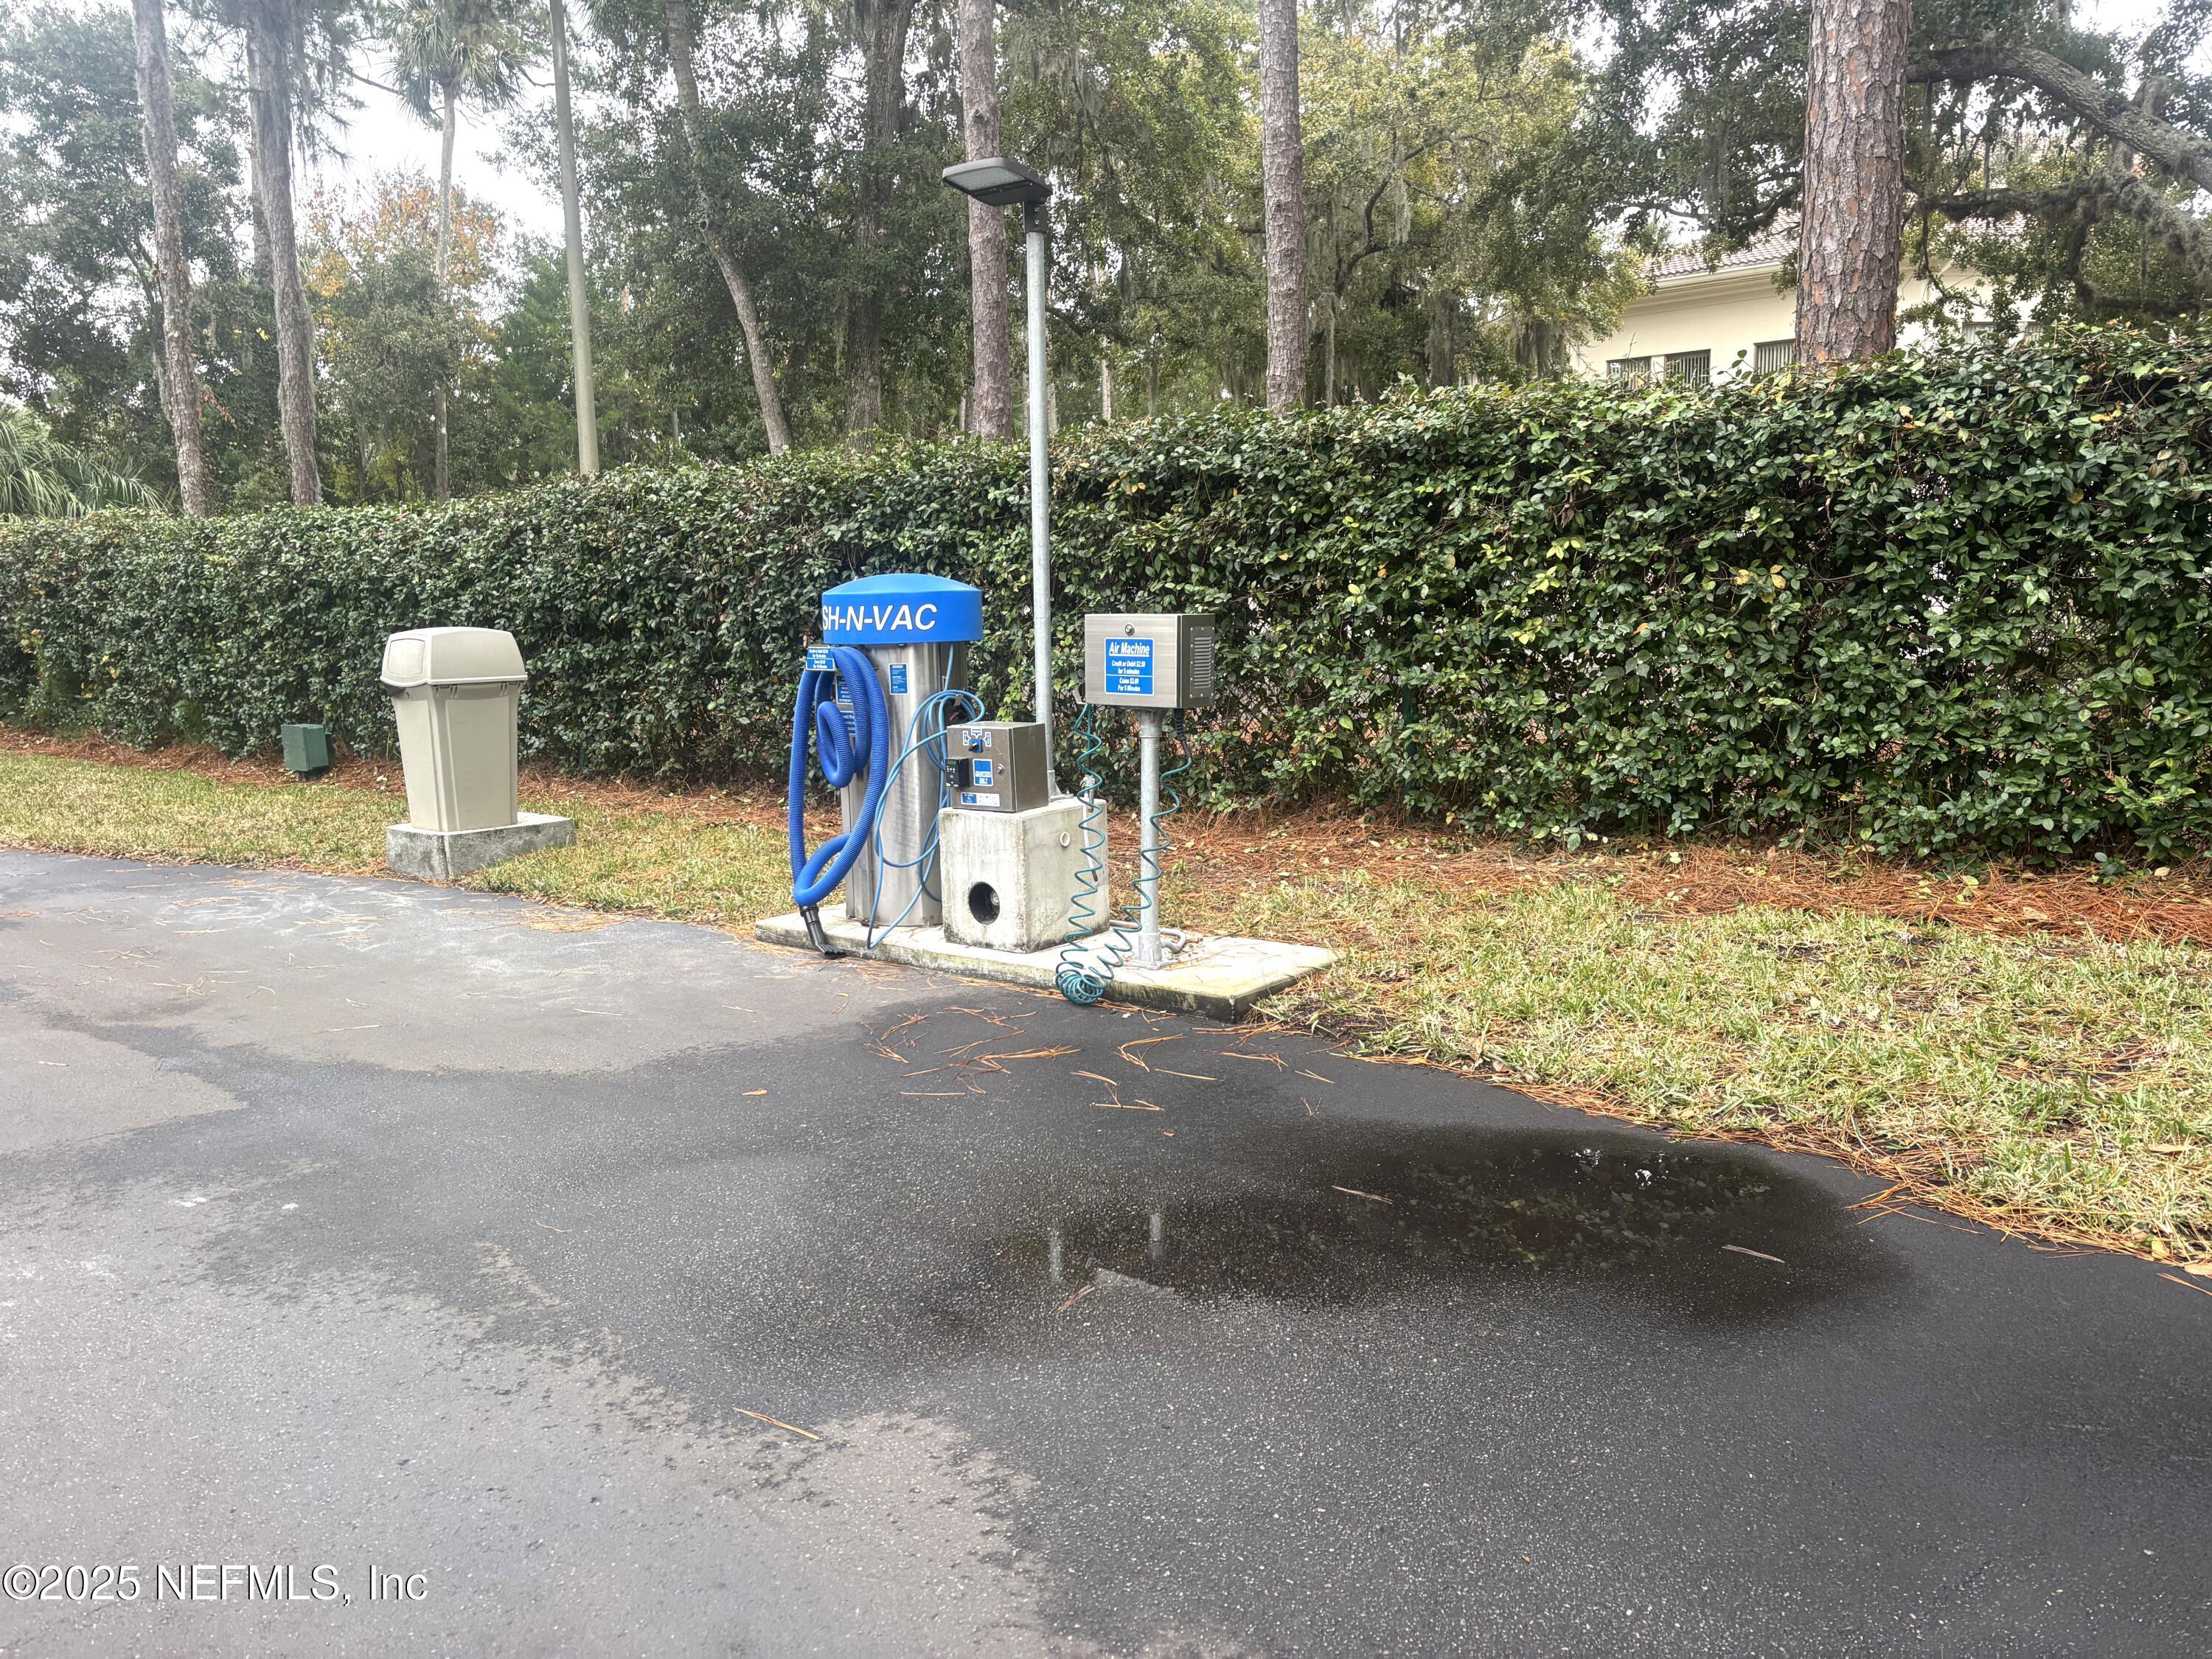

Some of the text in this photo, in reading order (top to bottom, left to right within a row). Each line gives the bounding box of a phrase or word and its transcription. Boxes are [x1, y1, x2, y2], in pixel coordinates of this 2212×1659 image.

[822, 603, 938, 631] SH-N-VAC
[1109, 641, 1150, 655] Air Machine
